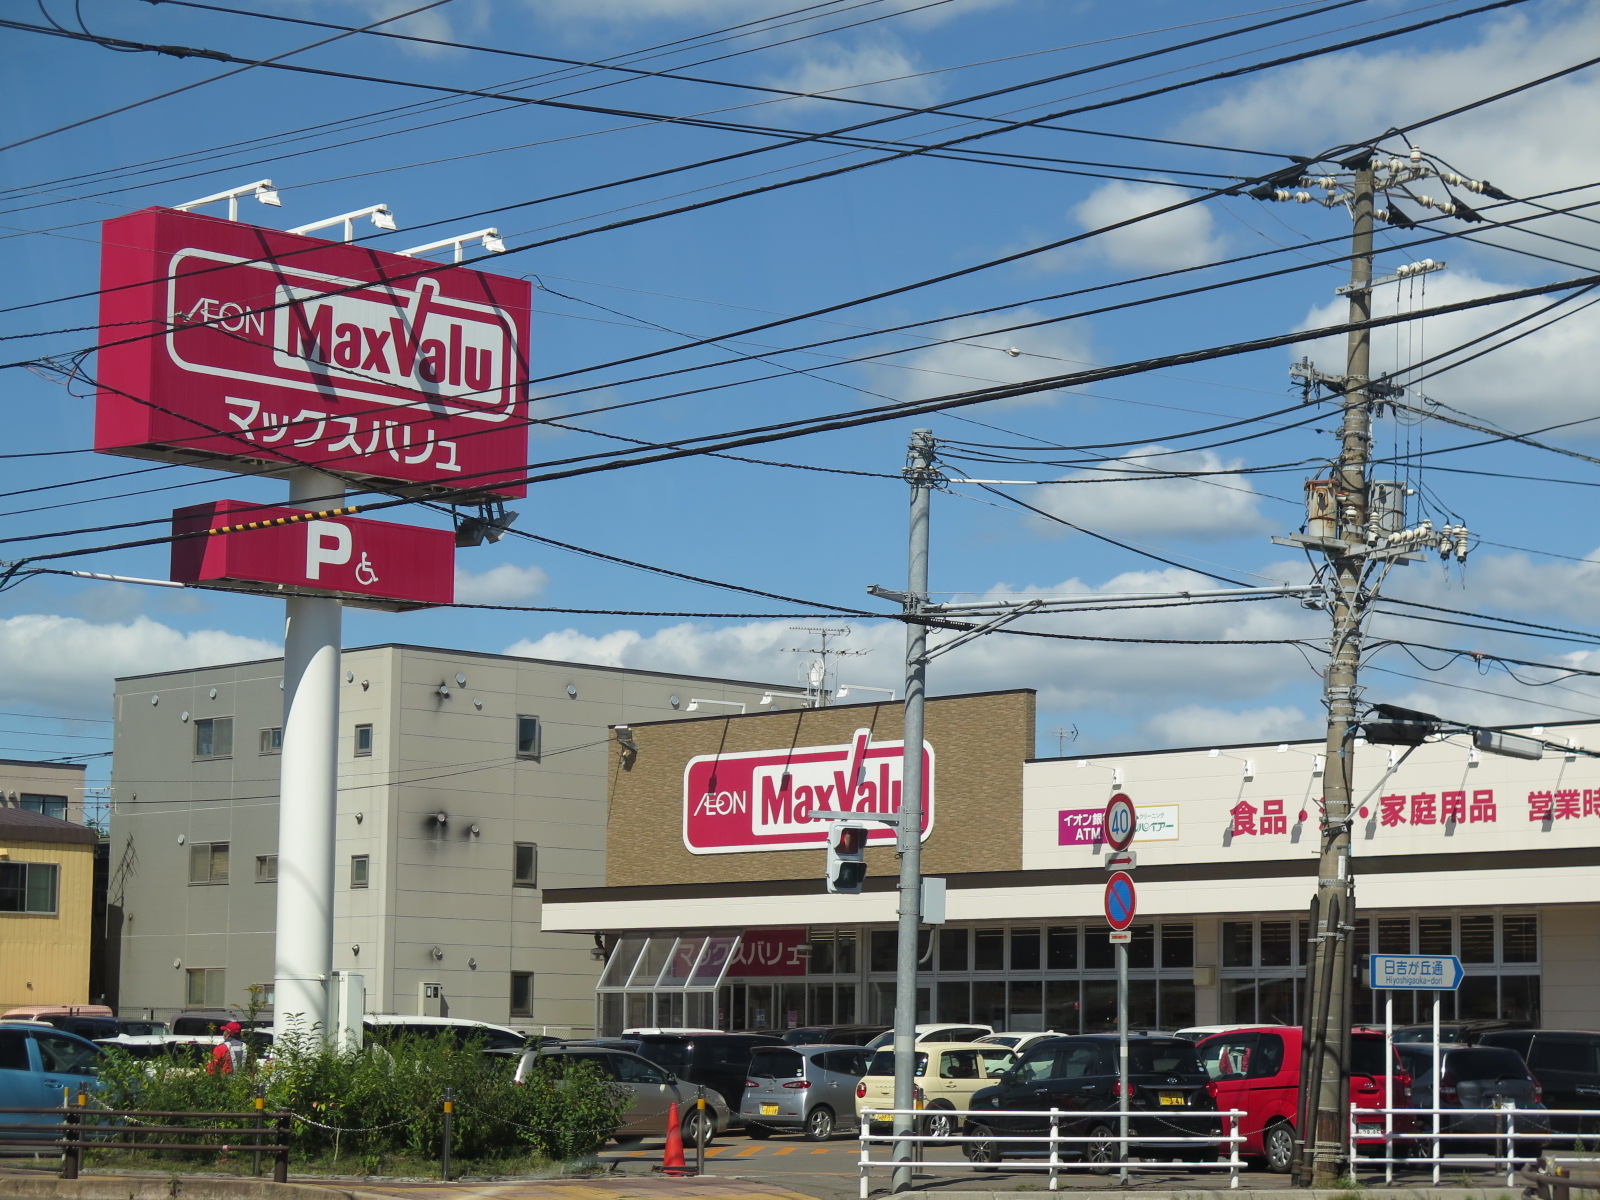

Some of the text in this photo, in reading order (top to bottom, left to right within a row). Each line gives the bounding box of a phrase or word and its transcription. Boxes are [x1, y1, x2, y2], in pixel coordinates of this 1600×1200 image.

[287, 285, 492, 392] MaxValu
[225, 395, 462, 472] マックスバリュ
[305, 520, 353, 580] P
[1075, 827, 1101, 841] ATM
[1111, 809, 1129, 835] 40
[1384, 960, 1443, 975] 日吉が丘通
[1385, 976, 1443, 985] Hiyoshigaoka-dori
